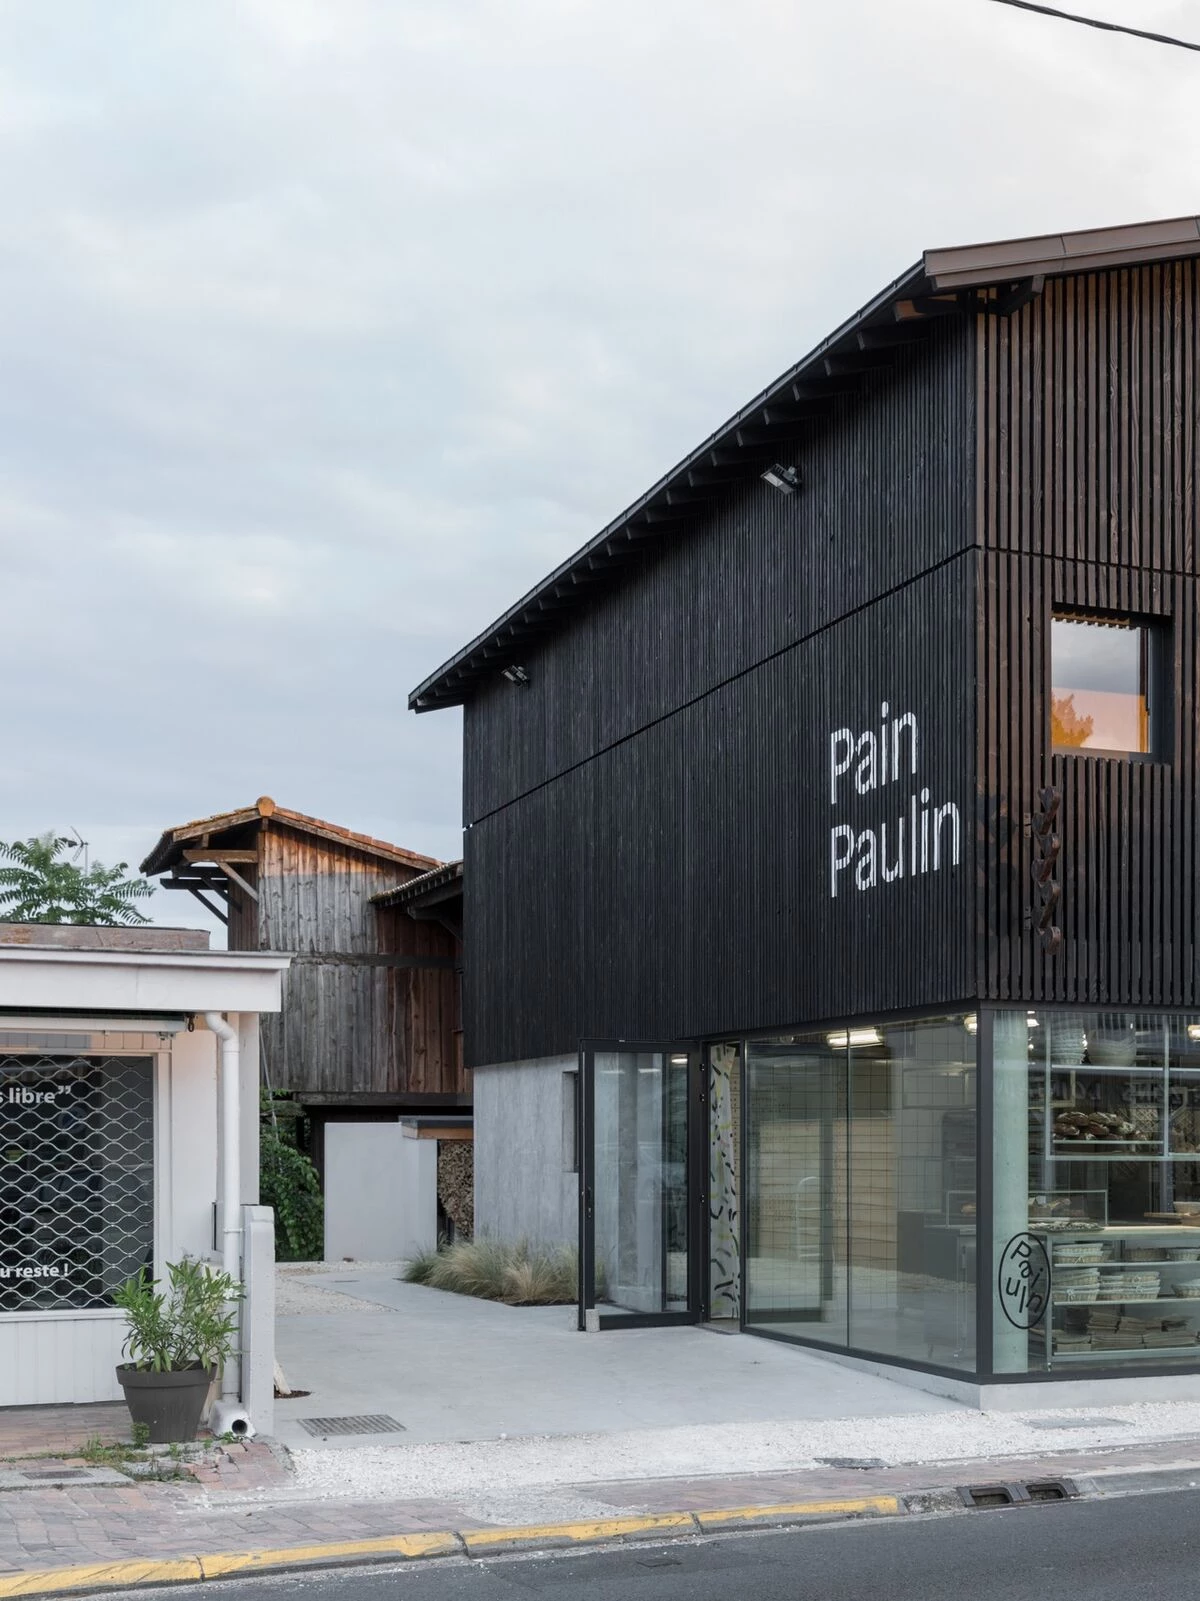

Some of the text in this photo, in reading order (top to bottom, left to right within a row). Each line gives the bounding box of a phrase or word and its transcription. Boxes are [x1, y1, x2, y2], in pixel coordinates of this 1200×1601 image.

[831, 701, 918, 804] Pain
[831, 787, 960, 898] Paulin
[16, 1264, 59, 1278] reste
